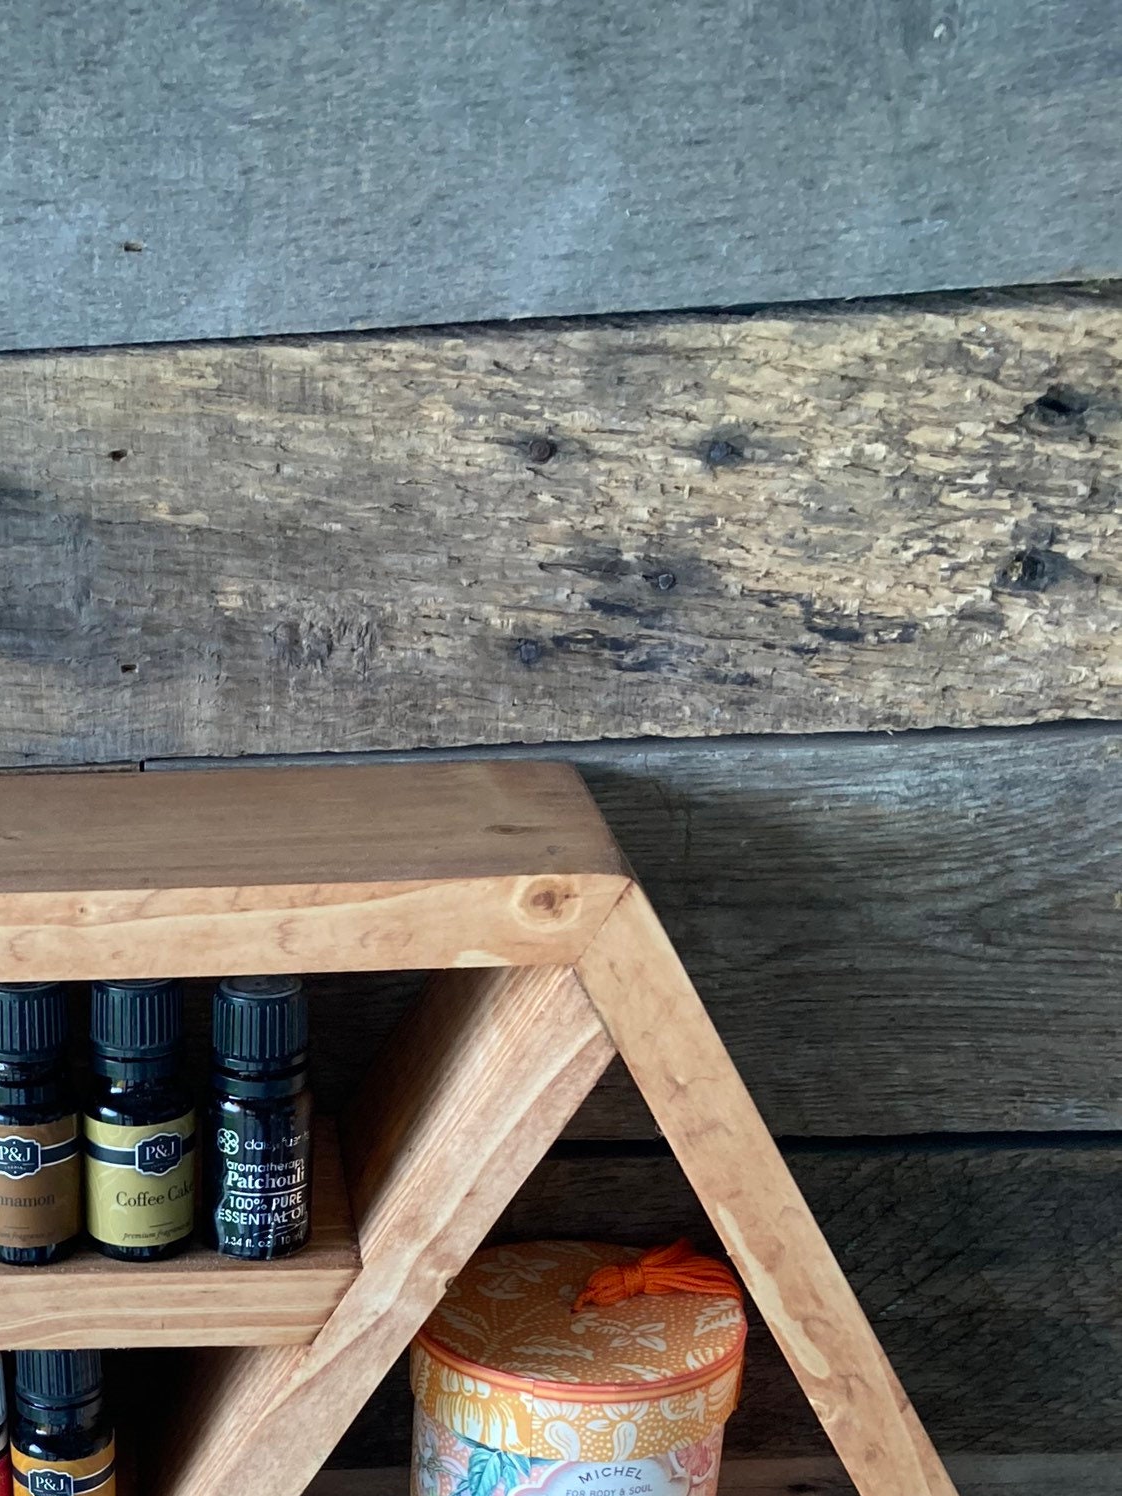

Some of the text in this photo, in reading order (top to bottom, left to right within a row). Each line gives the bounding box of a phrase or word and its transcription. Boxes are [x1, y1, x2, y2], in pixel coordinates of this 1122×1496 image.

[0, 1145, 31, 1162] P&J
[145, 1141, 175, 1161] P&J
[226, 1166, 305, 1189] Patchouli
[116, 1180, 194, 1208] Coffee Cake
[229, 1191, 303, 1211] 100% PURE
[218, 1208, 288, 1226] ESSENTIAL
[35, 1476, 64, 1491] P&J
[578, 1466, 643, 1484] MICHEL
[619, 1488, 626, 1496] &
[629, 1484, 653, 1496] SOUL
